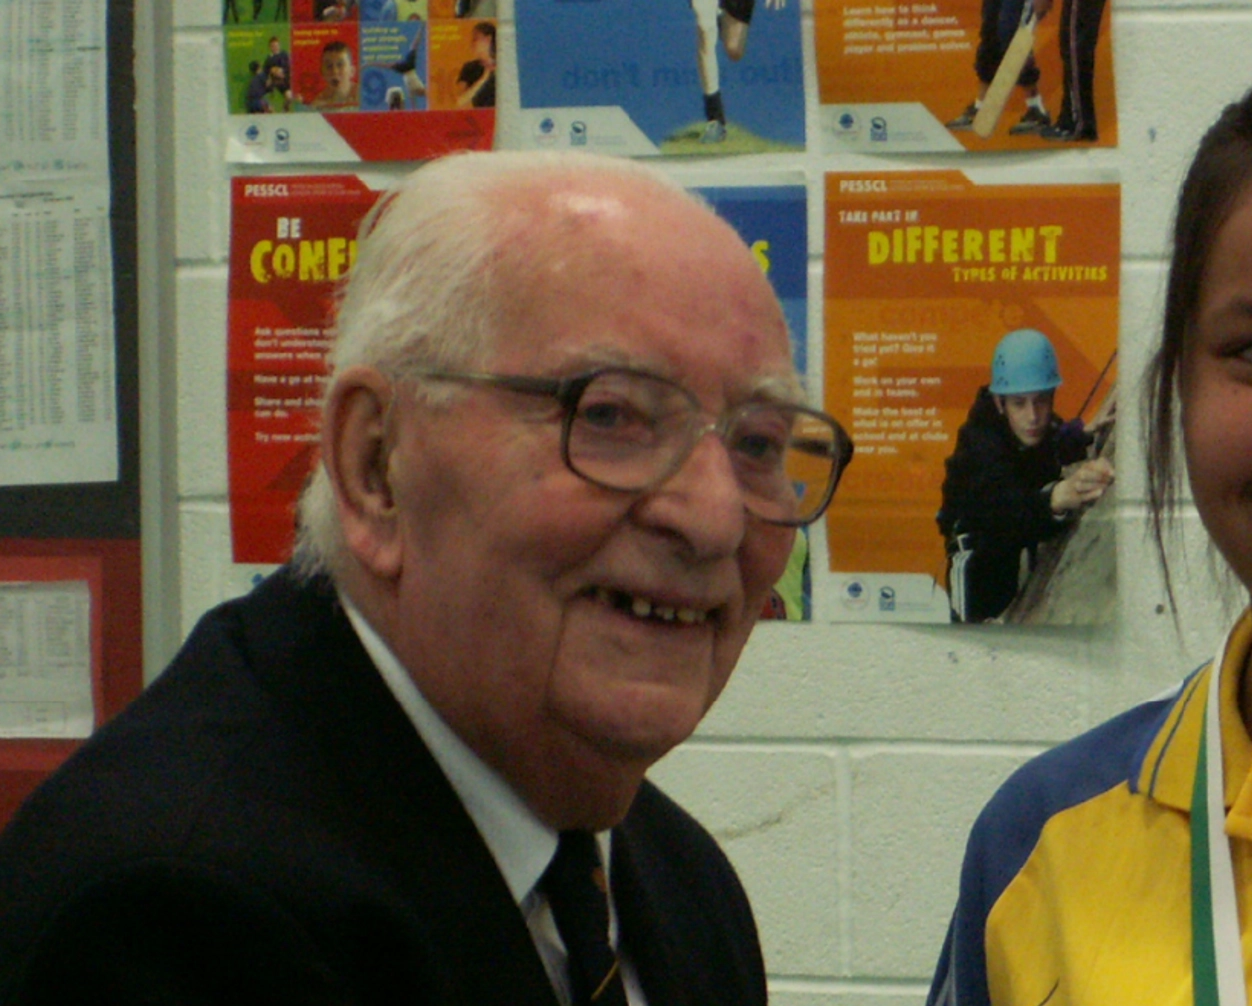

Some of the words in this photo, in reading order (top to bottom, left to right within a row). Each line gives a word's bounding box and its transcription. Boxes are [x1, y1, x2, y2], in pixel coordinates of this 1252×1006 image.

[245, 184, 289, 197] PESSCL
[839, 180, 887, 192] PESSCL
[839, 210, 868, 223] TAKE
[872, 210, 900, 222] PART
[905, 210, 918, 221] IN
[277, 217, 301, 239] BE
[868, 225, 1062, 265] DIFFERENT
[250, 238, 359, 283] CONFI
[954, 266, 995, 282] TYPES
[1002, 267, 1016, 281] OF
[1023, 266, 1107, 281] ACTIVITIES
